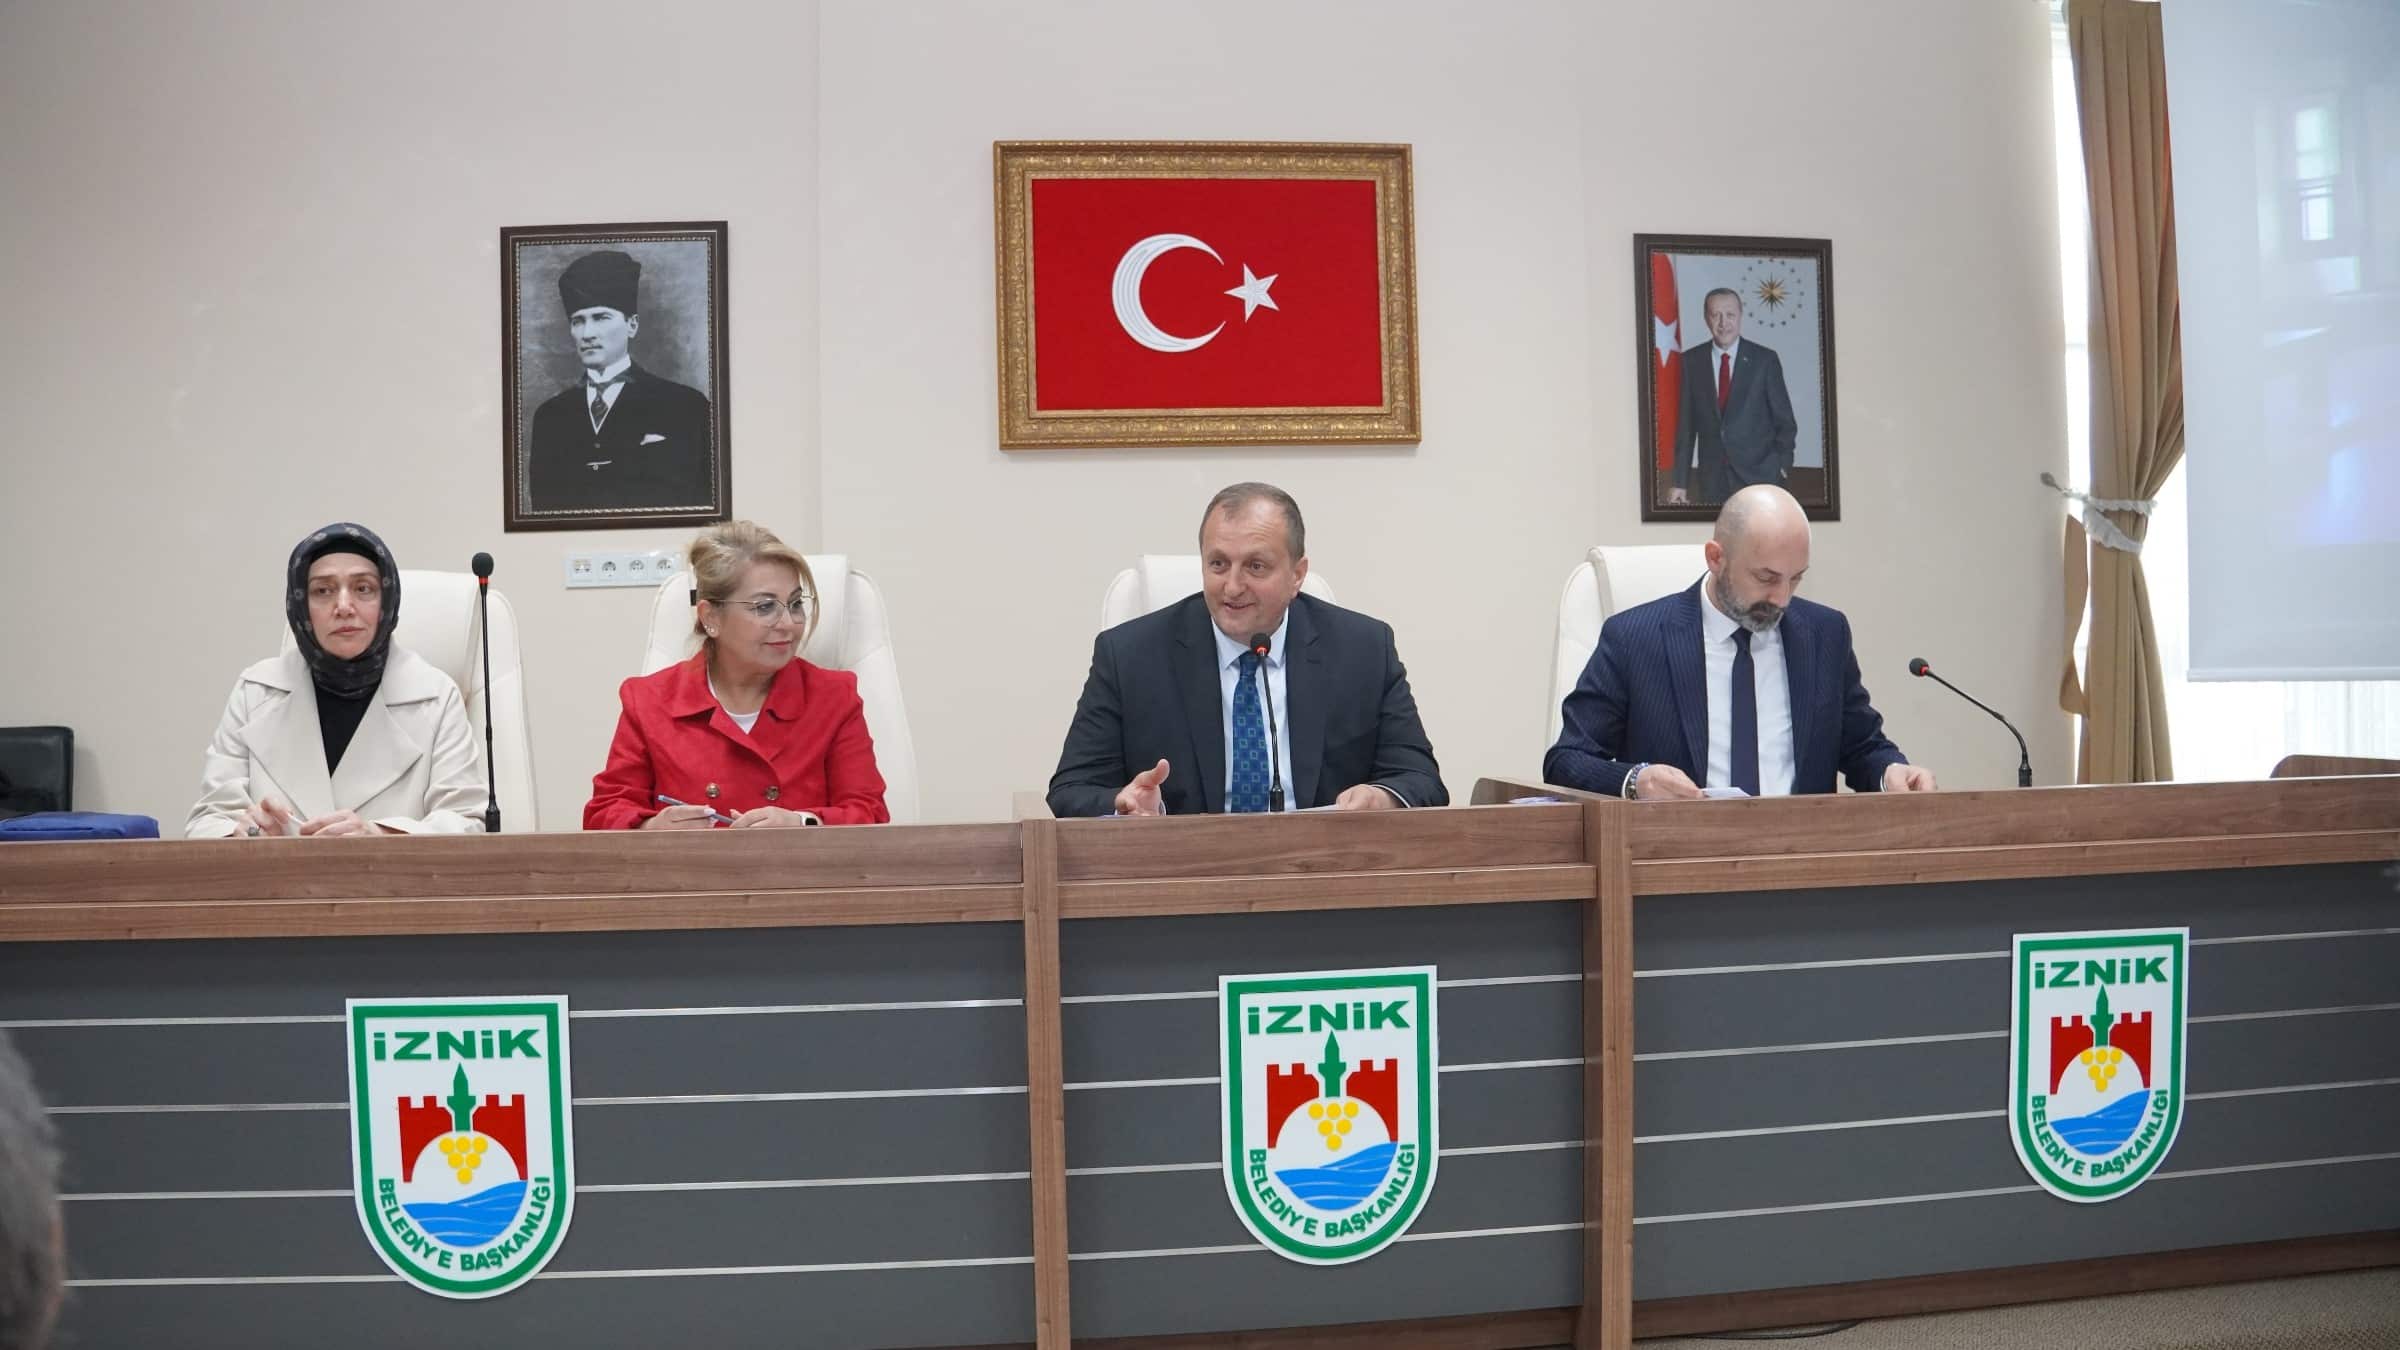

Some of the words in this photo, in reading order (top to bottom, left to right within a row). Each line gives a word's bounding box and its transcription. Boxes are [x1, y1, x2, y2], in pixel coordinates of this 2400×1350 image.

[2032, 1095, 2086, 1177] BELEDİYE
[2090, 1088, 2169, 1178] BAŞKANLIĞI
[378, 1178, 453, 1269] BELEDİYE
[460, 1177, 550, 1273] BAŞKANLIĞI
[1249, 1148, 1318, 1236] BELEDİYE
[1324, 1144, 1415, 1239] BAŞKANLIĞI
